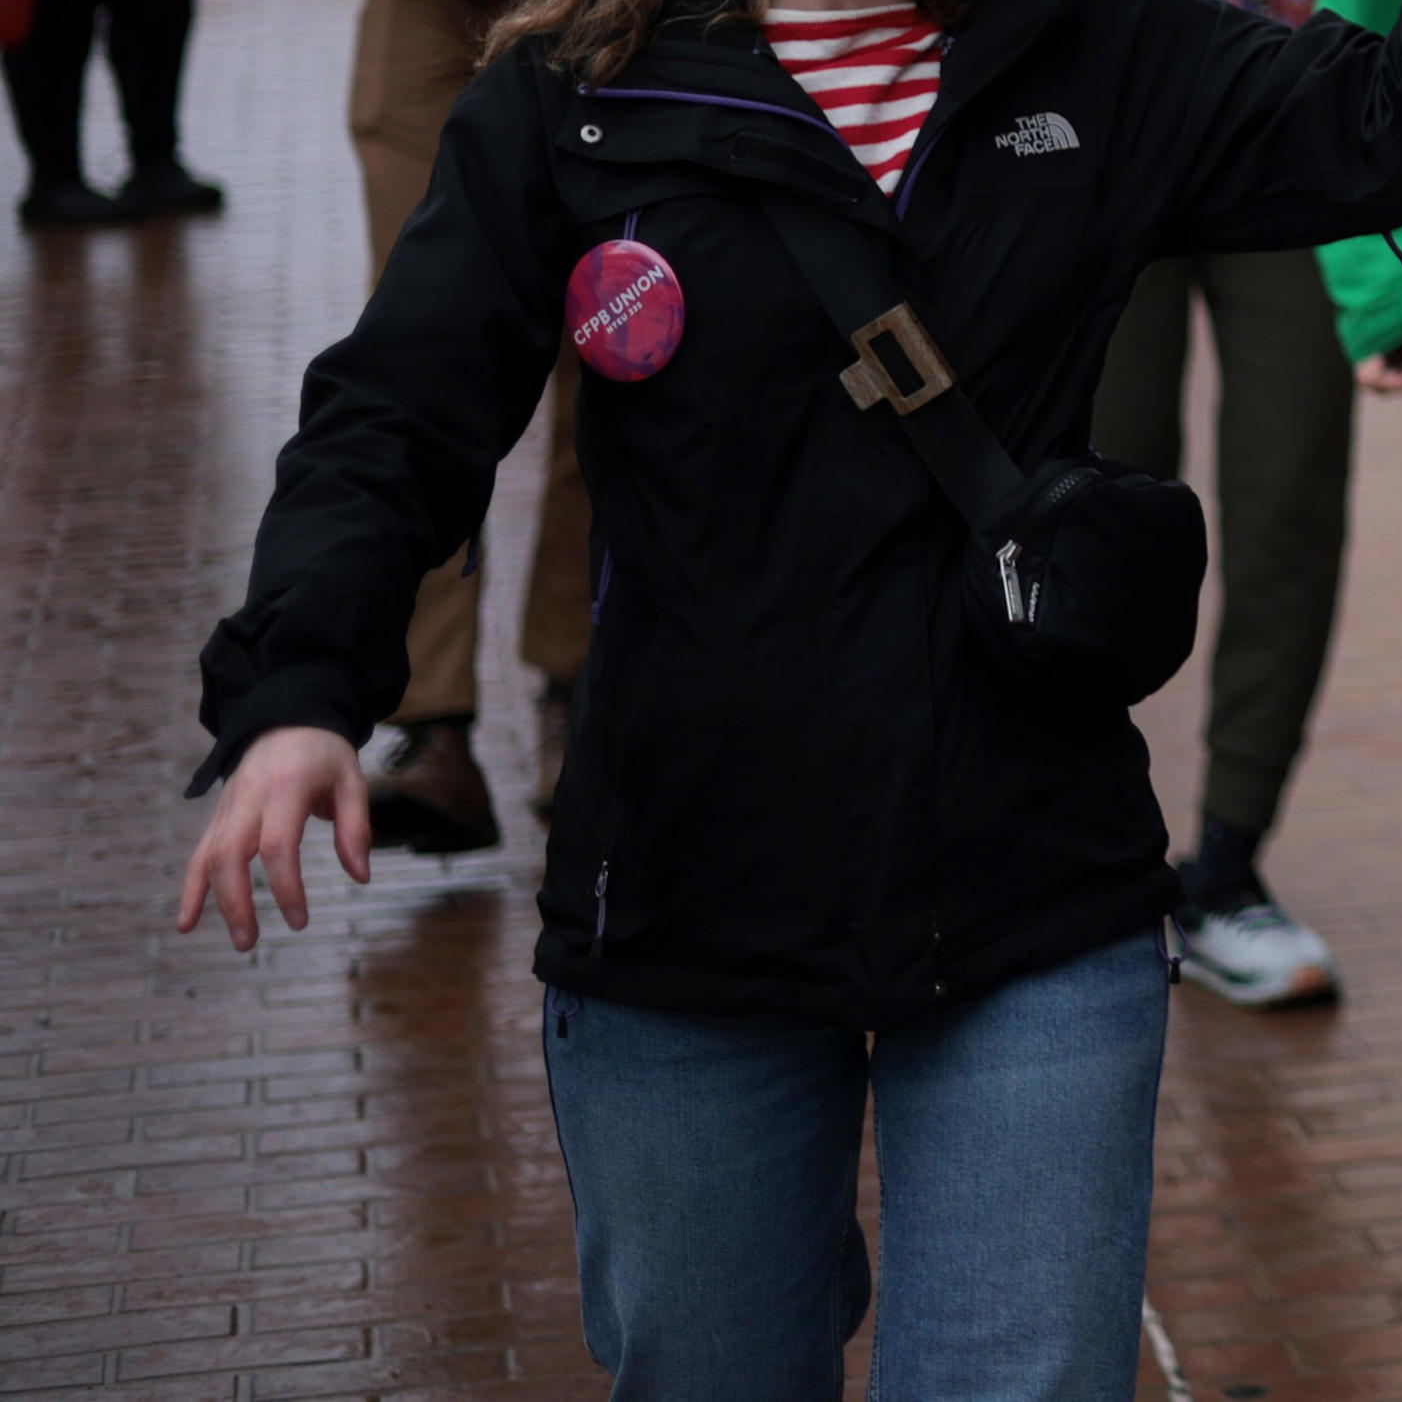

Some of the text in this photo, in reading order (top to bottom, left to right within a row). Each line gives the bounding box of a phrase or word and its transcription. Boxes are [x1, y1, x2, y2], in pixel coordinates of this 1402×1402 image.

[1015, 113, 1048, 131] THE
[994, 125, 1051, 150] NORTH
[1014, 138, 1056, 158] FACE
[574, 265, 665, 346] CFPB UNION
